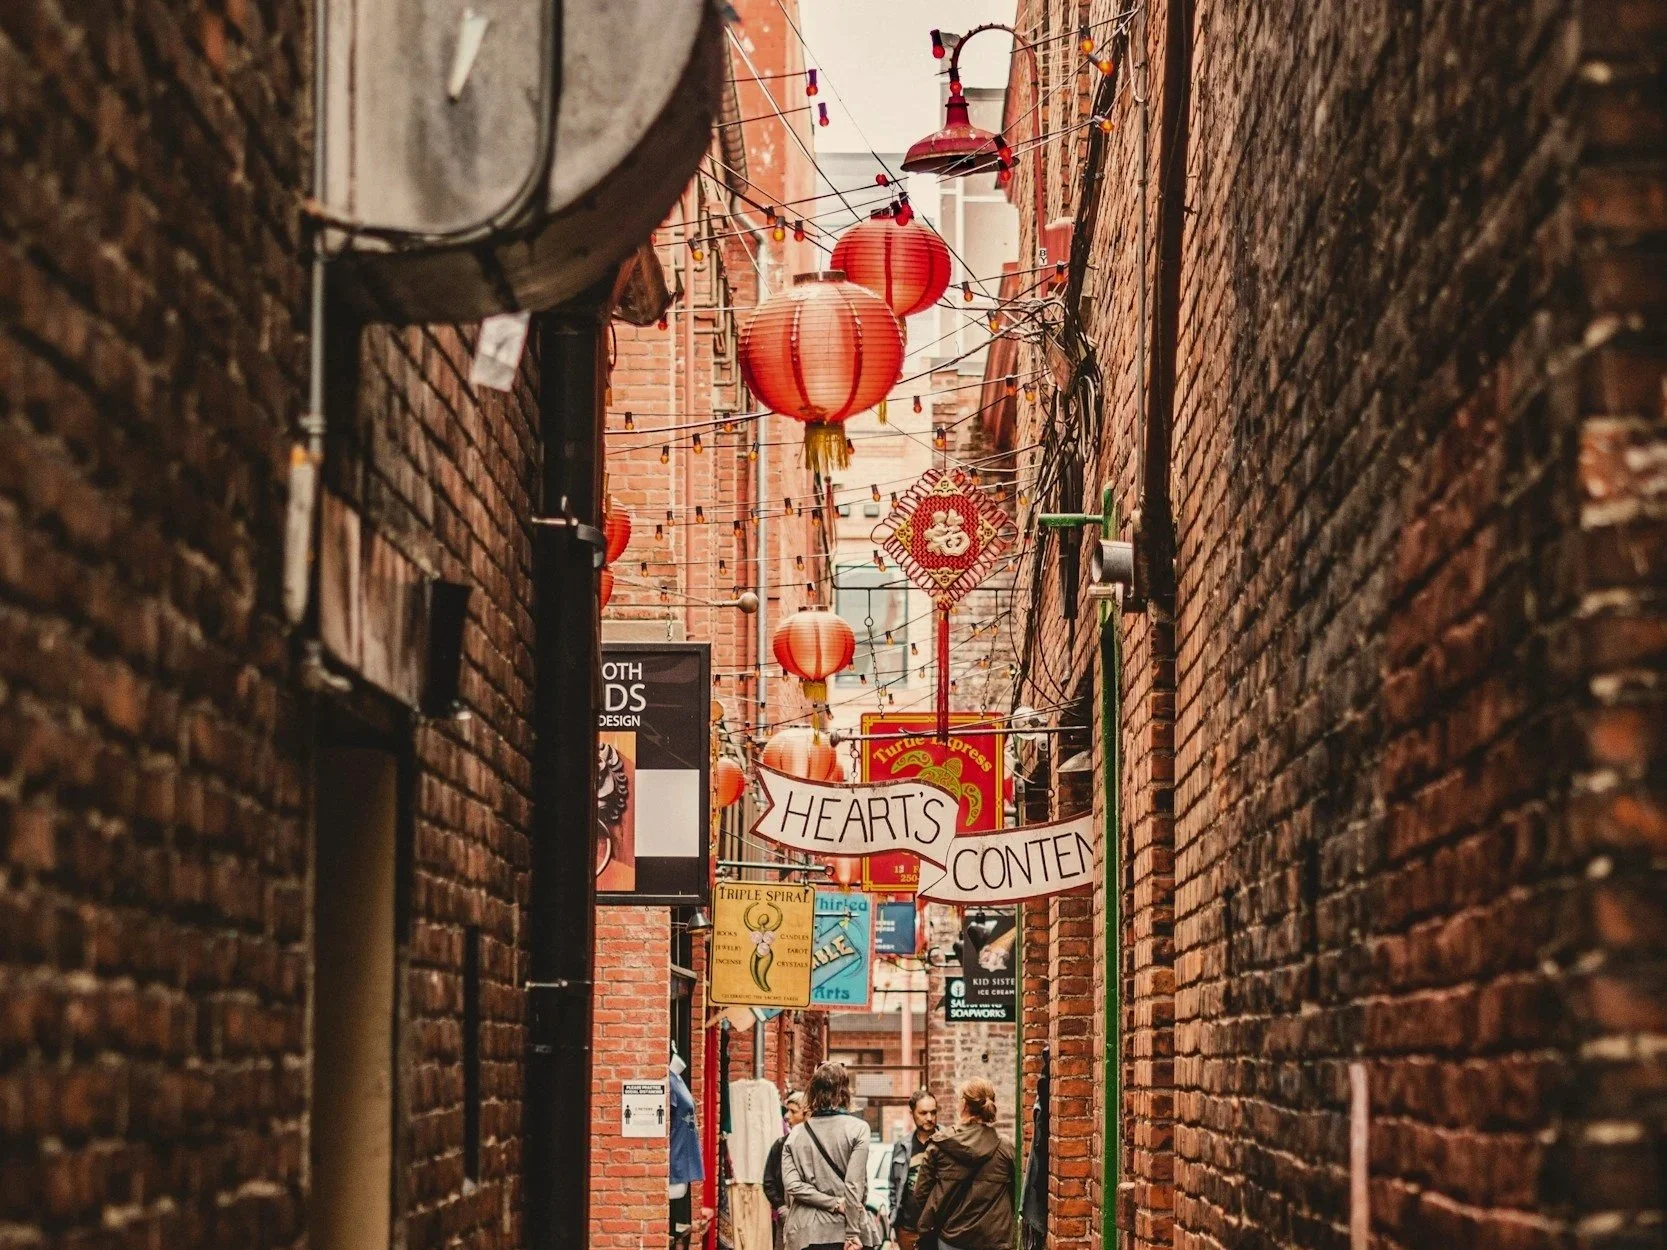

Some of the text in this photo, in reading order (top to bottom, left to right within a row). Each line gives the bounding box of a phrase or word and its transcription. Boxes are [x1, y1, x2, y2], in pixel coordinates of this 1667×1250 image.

[923, 509, 970, 557] 福
[602, 662, 643, 680] OTH
[605, 683, 647, 712] DS
[598, 715, 641, 727] DESIGN
[780, 791, 945, 845] HEART'S
[718, 886, 811, 904] TRIPLE SPIRAL
[812, 897, 868, 912] hirled
[715, 958, 742, 966] INCENSE
[776, 961, 808, 969] CRYSTALS
[972, 978, 989, 986] KID
[814, 986, 850, 1000] Arts
[950, 1008, 1007, 1018] SOAPWORKS
